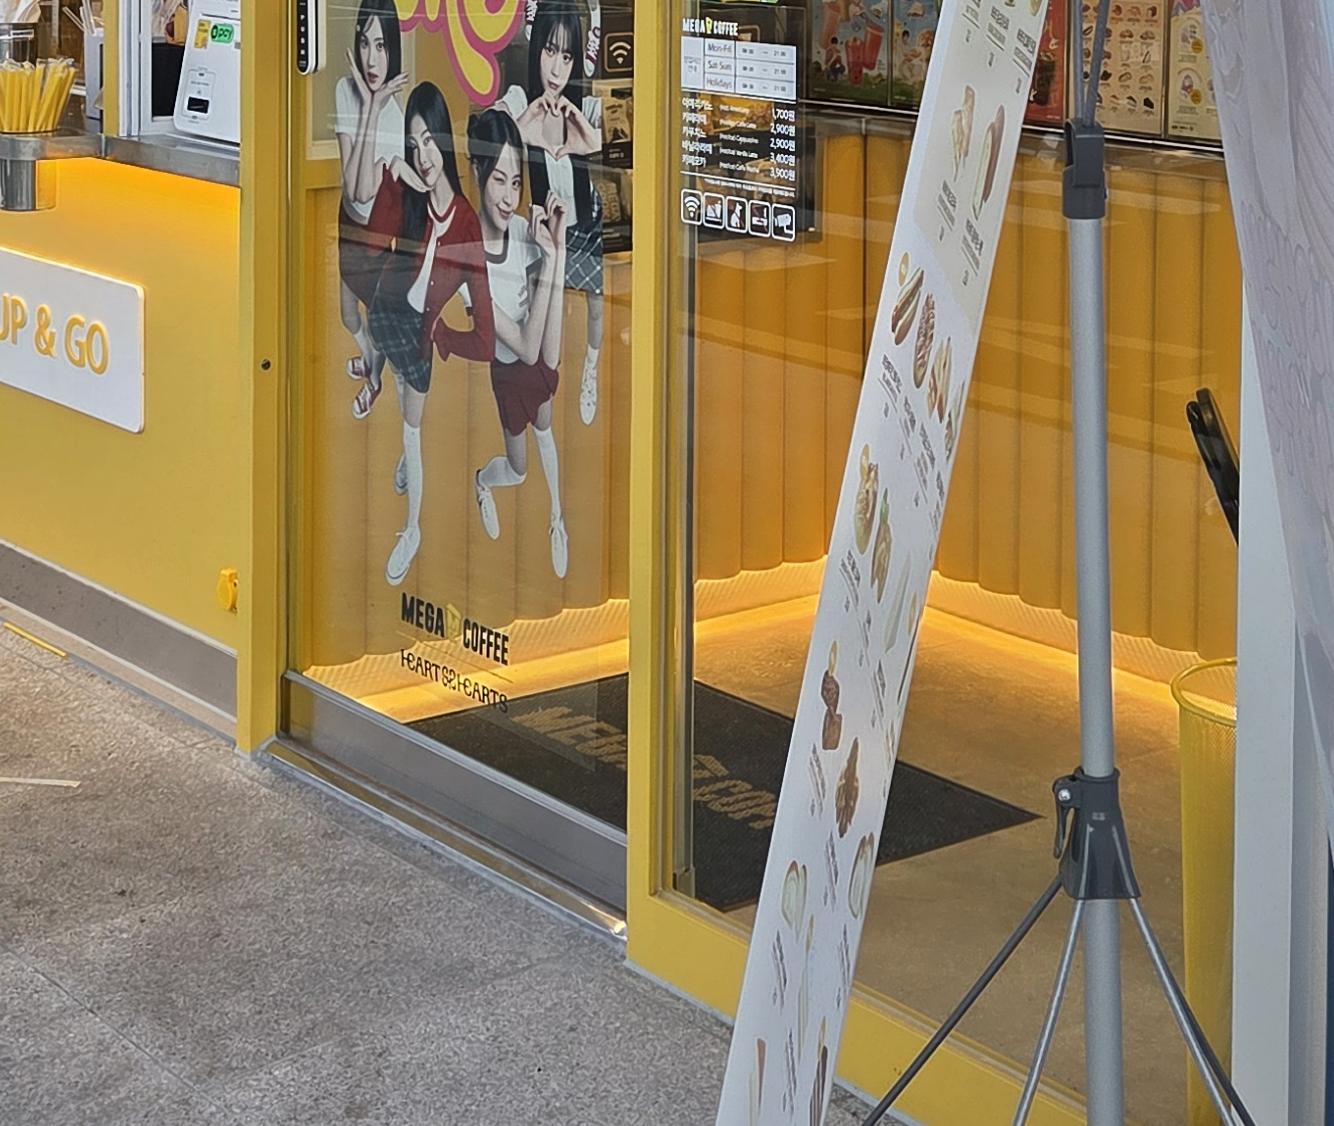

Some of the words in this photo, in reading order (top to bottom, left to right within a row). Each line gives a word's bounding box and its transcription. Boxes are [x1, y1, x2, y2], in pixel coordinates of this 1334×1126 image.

[682, 18, 706, 33] MEGA
[713, 20, 739, 36] COFFEE
[771, 107, 796, 122] 1,700원
[769, 123, 796, 137] 2,900원
[769, 138, 796, 152] 2,900원
[769, 152, 796, 166] 3,400원
[769, 167, 796, 181] 3,900원
[34, 303, 57, 359] &
[64, 313, 110, 375] GO
[401, 592, 445, 638] MEGA
[462, 617, 509, 666] COFFEE
